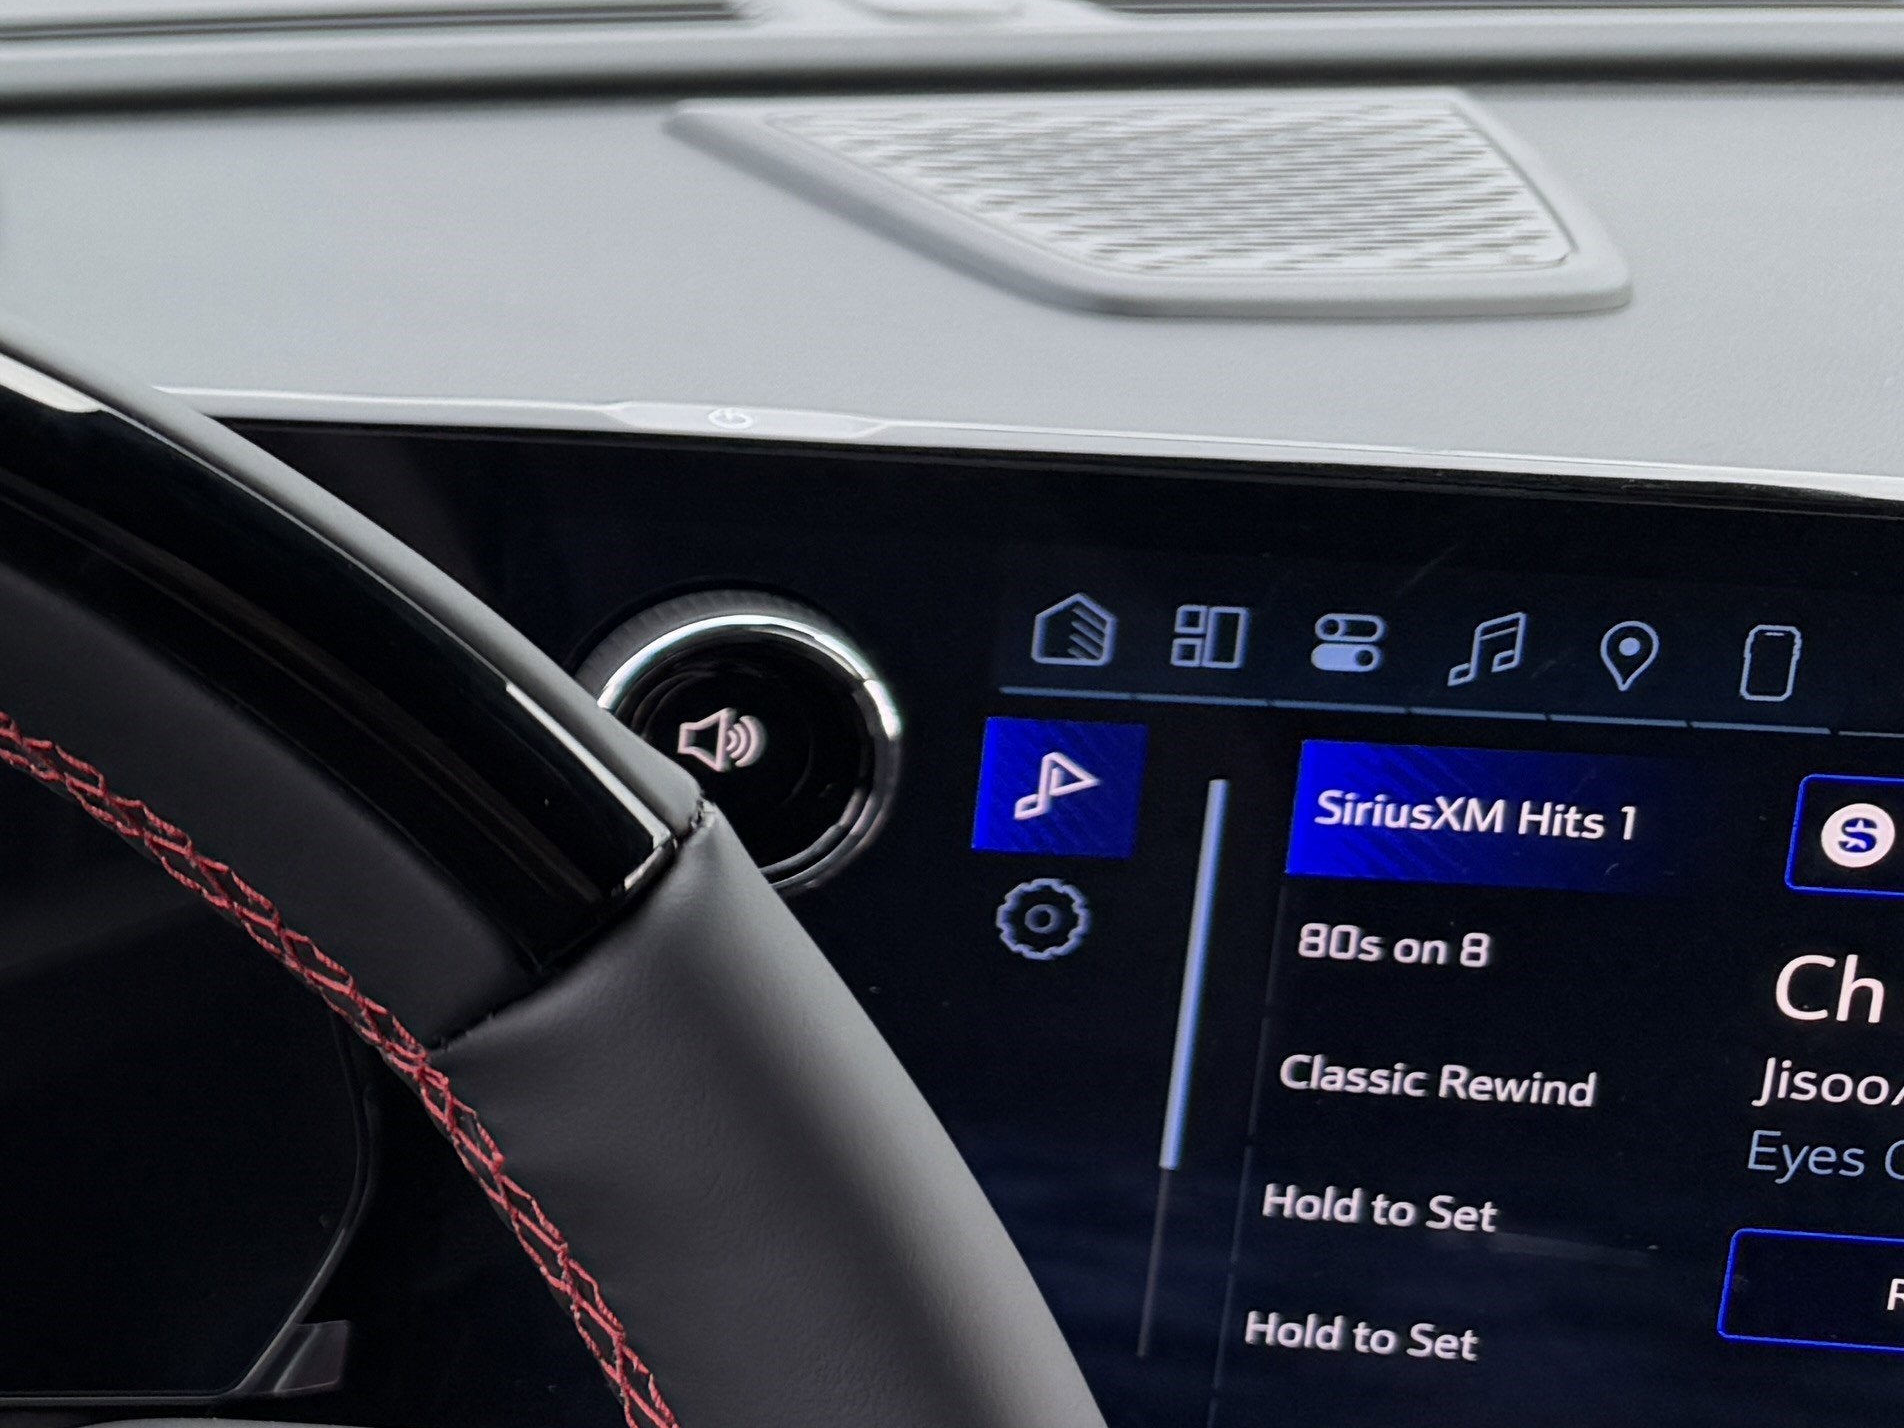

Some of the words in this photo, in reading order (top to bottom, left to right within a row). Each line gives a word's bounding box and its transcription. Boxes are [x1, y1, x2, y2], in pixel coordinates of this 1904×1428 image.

[1313, 788, 1507, 834] SiriusXM
[1518, 800, 1606, 839] Hits
[1620, 805, 1637, 841] 1
[1298, 922, 1384, 962] 80s
[1393, 937, 1448, 965] on
[1459, 931, 1491, 969] 8
[1775, 953, 1886, 1025] Ch
[1280, 1053, 1429, 1098] Classic
[1438, 1064, 1597, 1108] Rewind
[1747, 1129, 1866, 1185] Eyes
[1262, 1183, 1366, 1224] Hold
[1372, 1193, 1418, 1228] to
[1425, 1194, 1500, 1233] Set
[1245, 1310, 1346, 1352] Hold
[1352, 1322, 1399, 1355] to
[1406, 1322, 1481, 1362] Set
